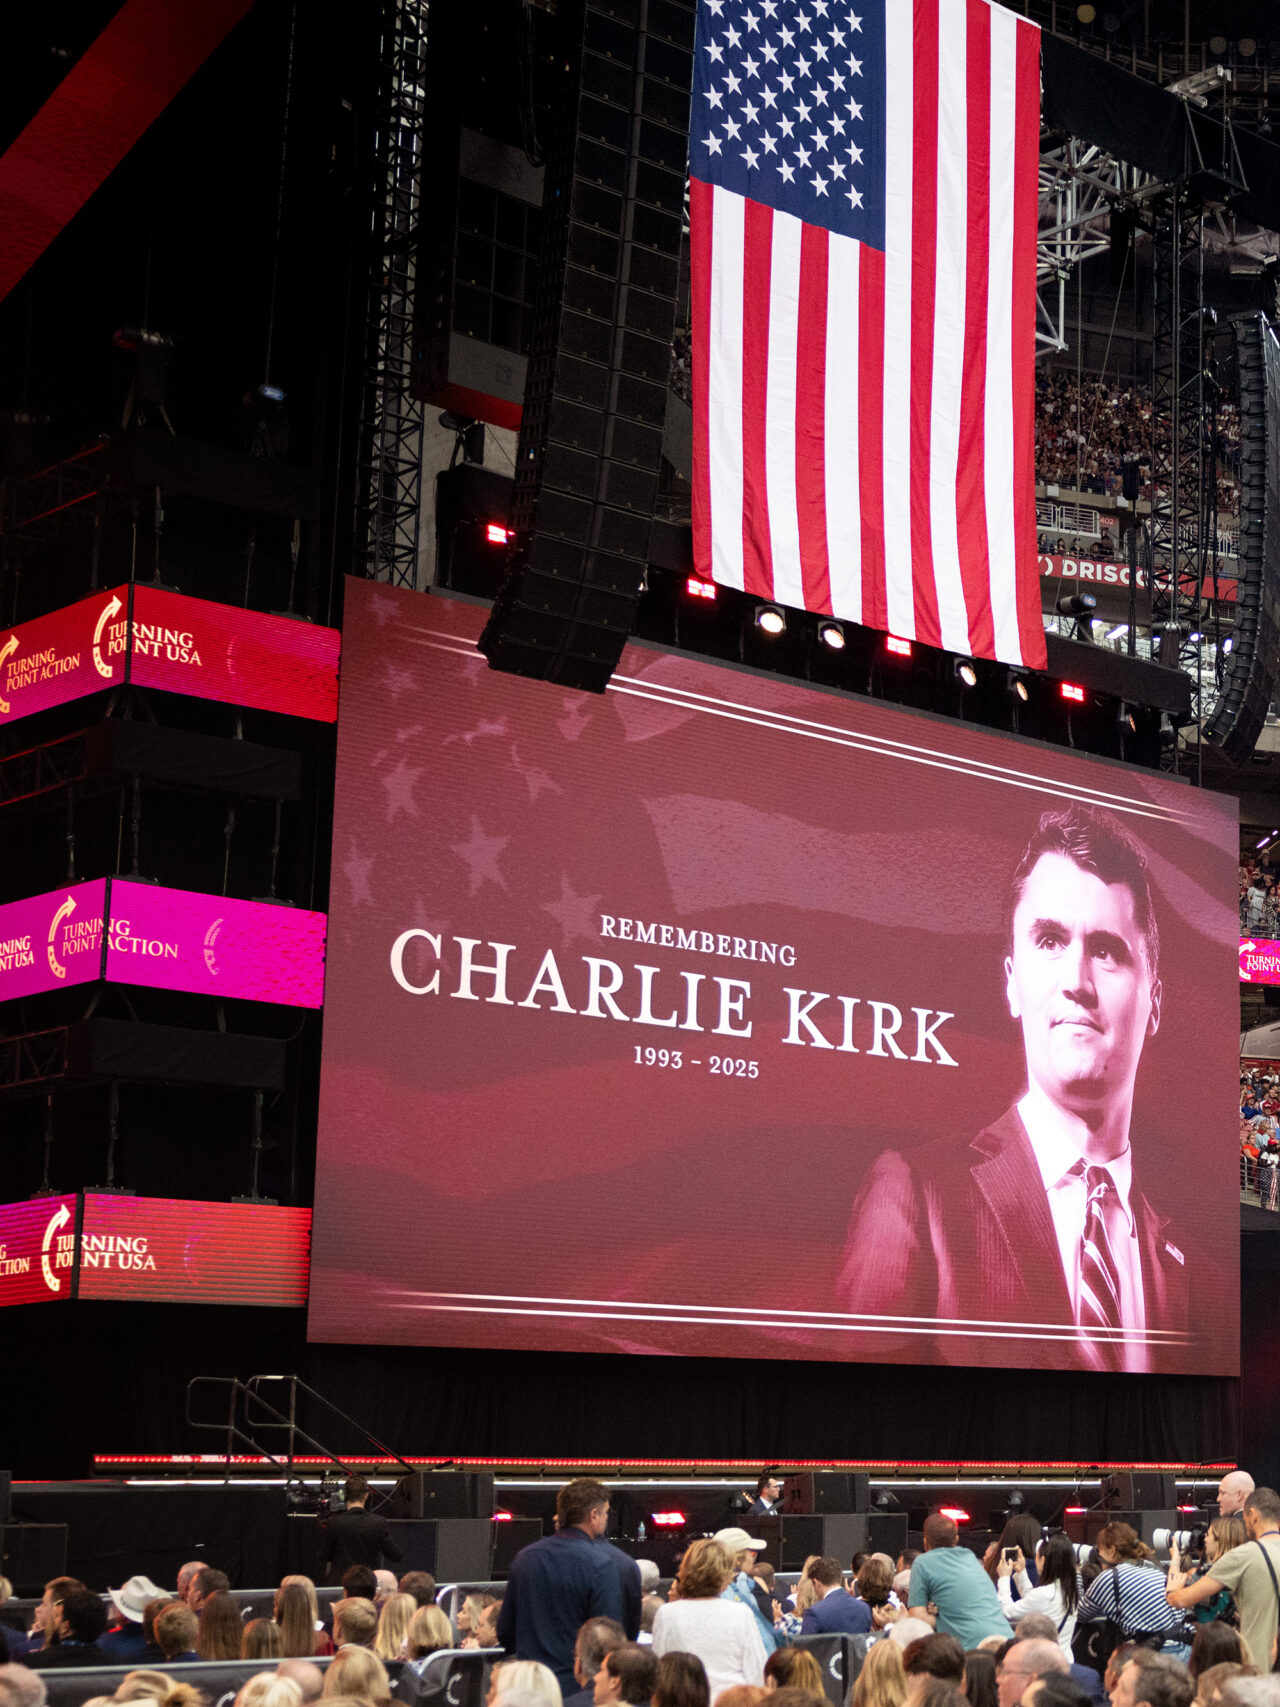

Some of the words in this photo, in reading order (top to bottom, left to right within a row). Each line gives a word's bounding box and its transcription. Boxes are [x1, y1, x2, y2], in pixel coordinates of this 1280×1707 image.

[1100, 516, 1114, 525] 402
[108, 620, 193, 648] TURNING
[7, 648, 55, 677] TURNING
[108, 636, 163, 657] POINT
[166, 644, 202, 666] USA
[6, 668, 39, 693] POINT
[40, 653, 80, 681] ACTION
[63, 917, 131, 940] TURNING
[600, 914, 798, 967] REMEMBERING
[15, 950, 35, 968] USA
[63, 934, 97, 957] POINT
[98, 934, 179, 959] ACTION
[1246, 962, 1275, 972] POINT
[389, 928, 754, 1038] CHARLIE
[782, 987, 960, 1067] KIRK
[633, 1045, 684, 1070] 1993
[710, 1054, 760, 1080] 2025
[56, 1234, 148, 1253] TURNING
[56, 1251, 115, 1268] POINT
[118, 1253, 157, 1270] USA
